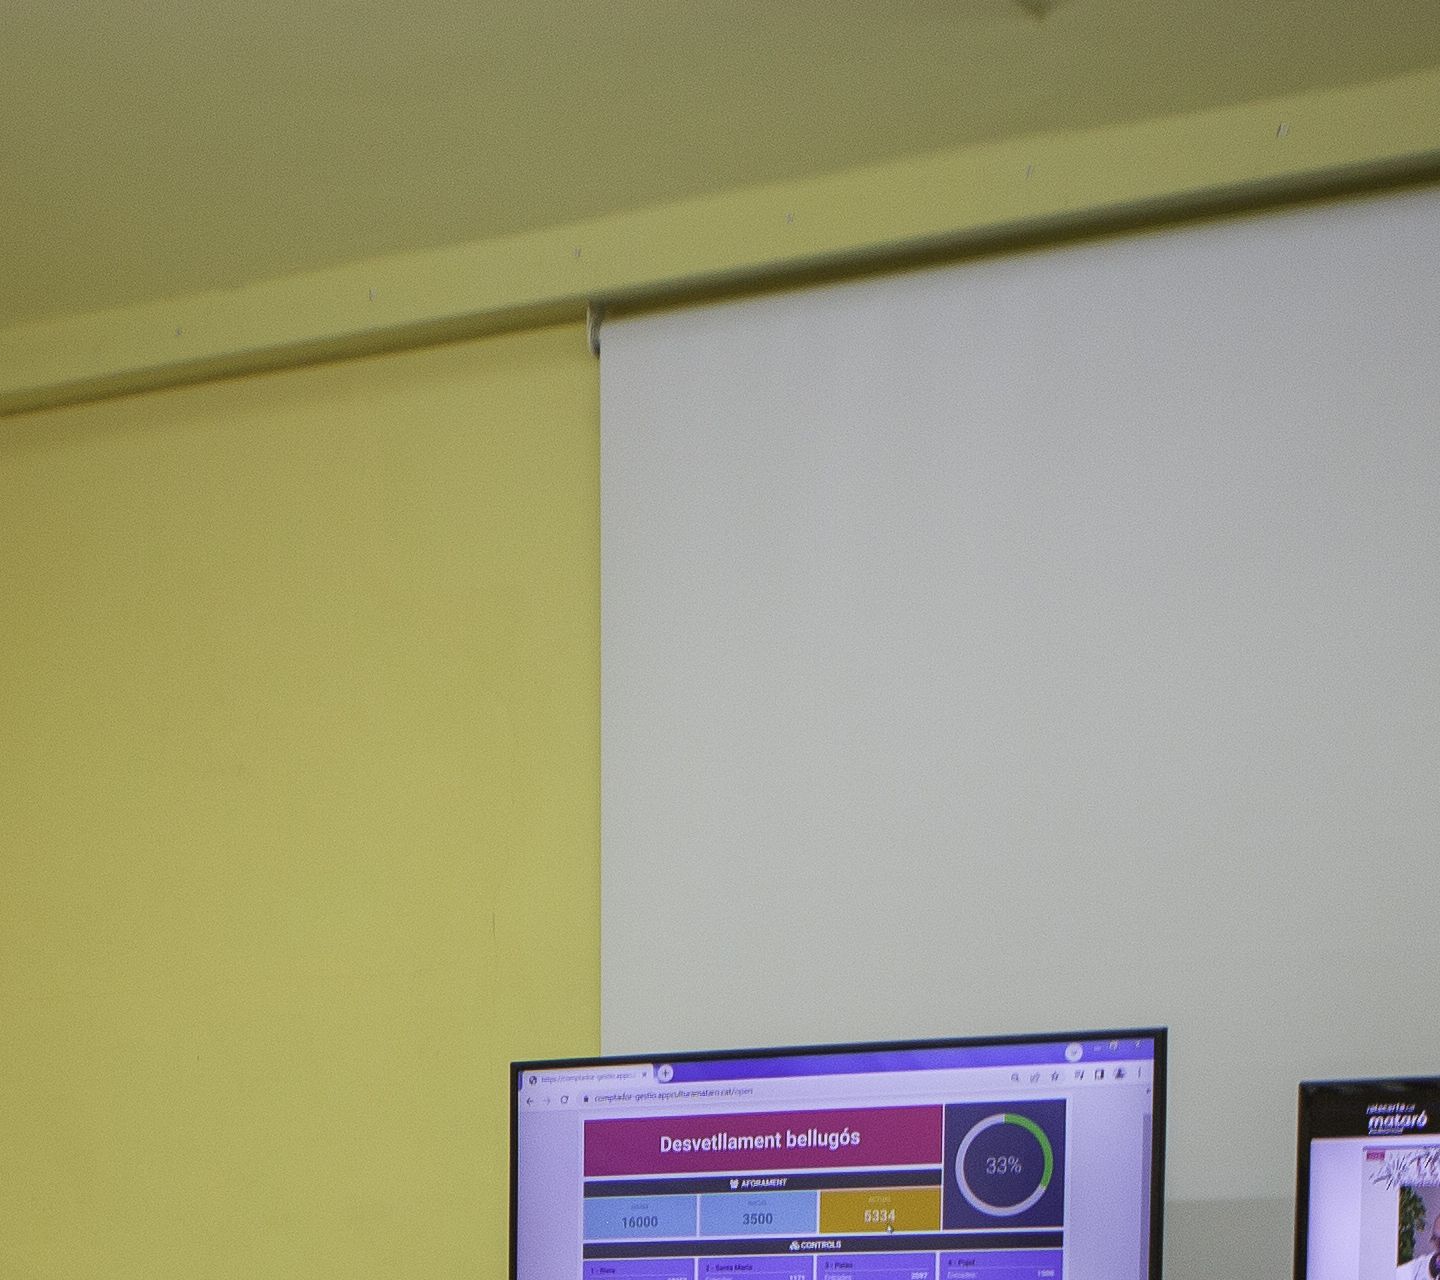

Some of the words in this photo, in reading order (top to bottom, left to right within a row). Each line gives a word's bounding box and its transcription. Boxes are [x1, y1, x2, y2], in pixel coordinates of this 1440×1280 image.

[1368, 1110, 1429, 1130] mataró
[661, 1130, 782, 1153] Desvetllament
[786, 1127, 861, 1152] bellugós
[985, 1156, 1022, 1176] 33%
[741, 1177, 788, 1189] AFORAMENT
[621, 1215, 659, 1229] 16000
[742, 1212, 774, 1226] 3500
[800, 1240, 842, 1251] CONTROLS
